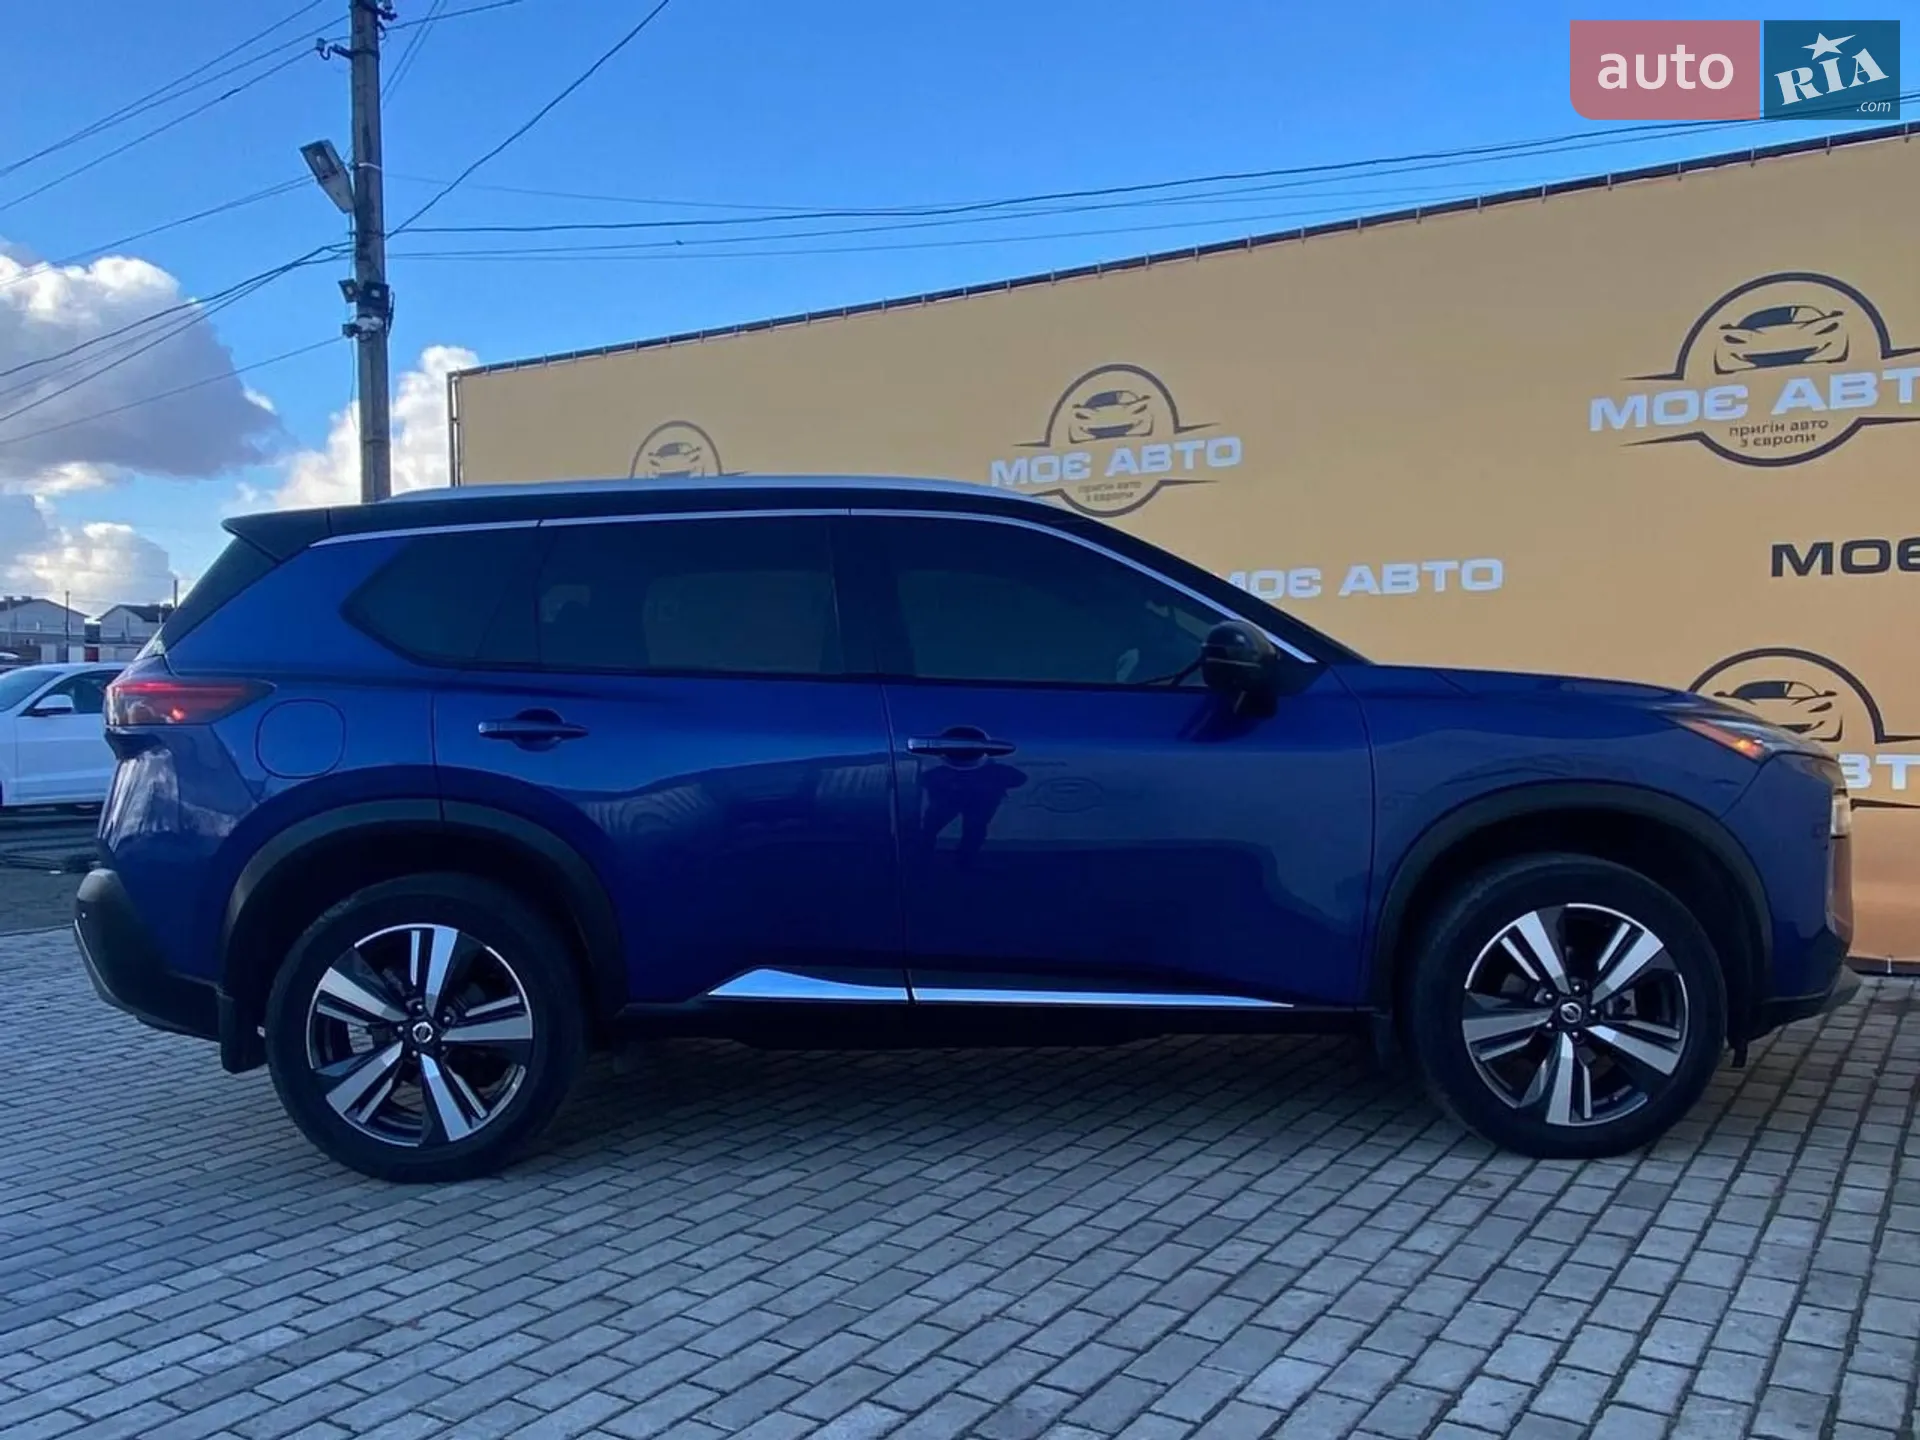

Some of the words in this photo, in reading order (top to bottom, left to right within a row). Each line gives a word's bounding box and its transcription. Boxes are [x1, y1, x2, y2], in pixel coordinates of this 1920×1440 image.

[1589, 384, 1749, 432] МОЄ
[1729, 421, 1785, 437] пригін
[1790, 419, 1829, 432] авто
[1753, 433, 1817, 448] європи
[990, 451, 1092, 488] МОЄ
[1104, 435, 1243, 478] АВТО
[1337, 557, 1504, 597] АВТО
